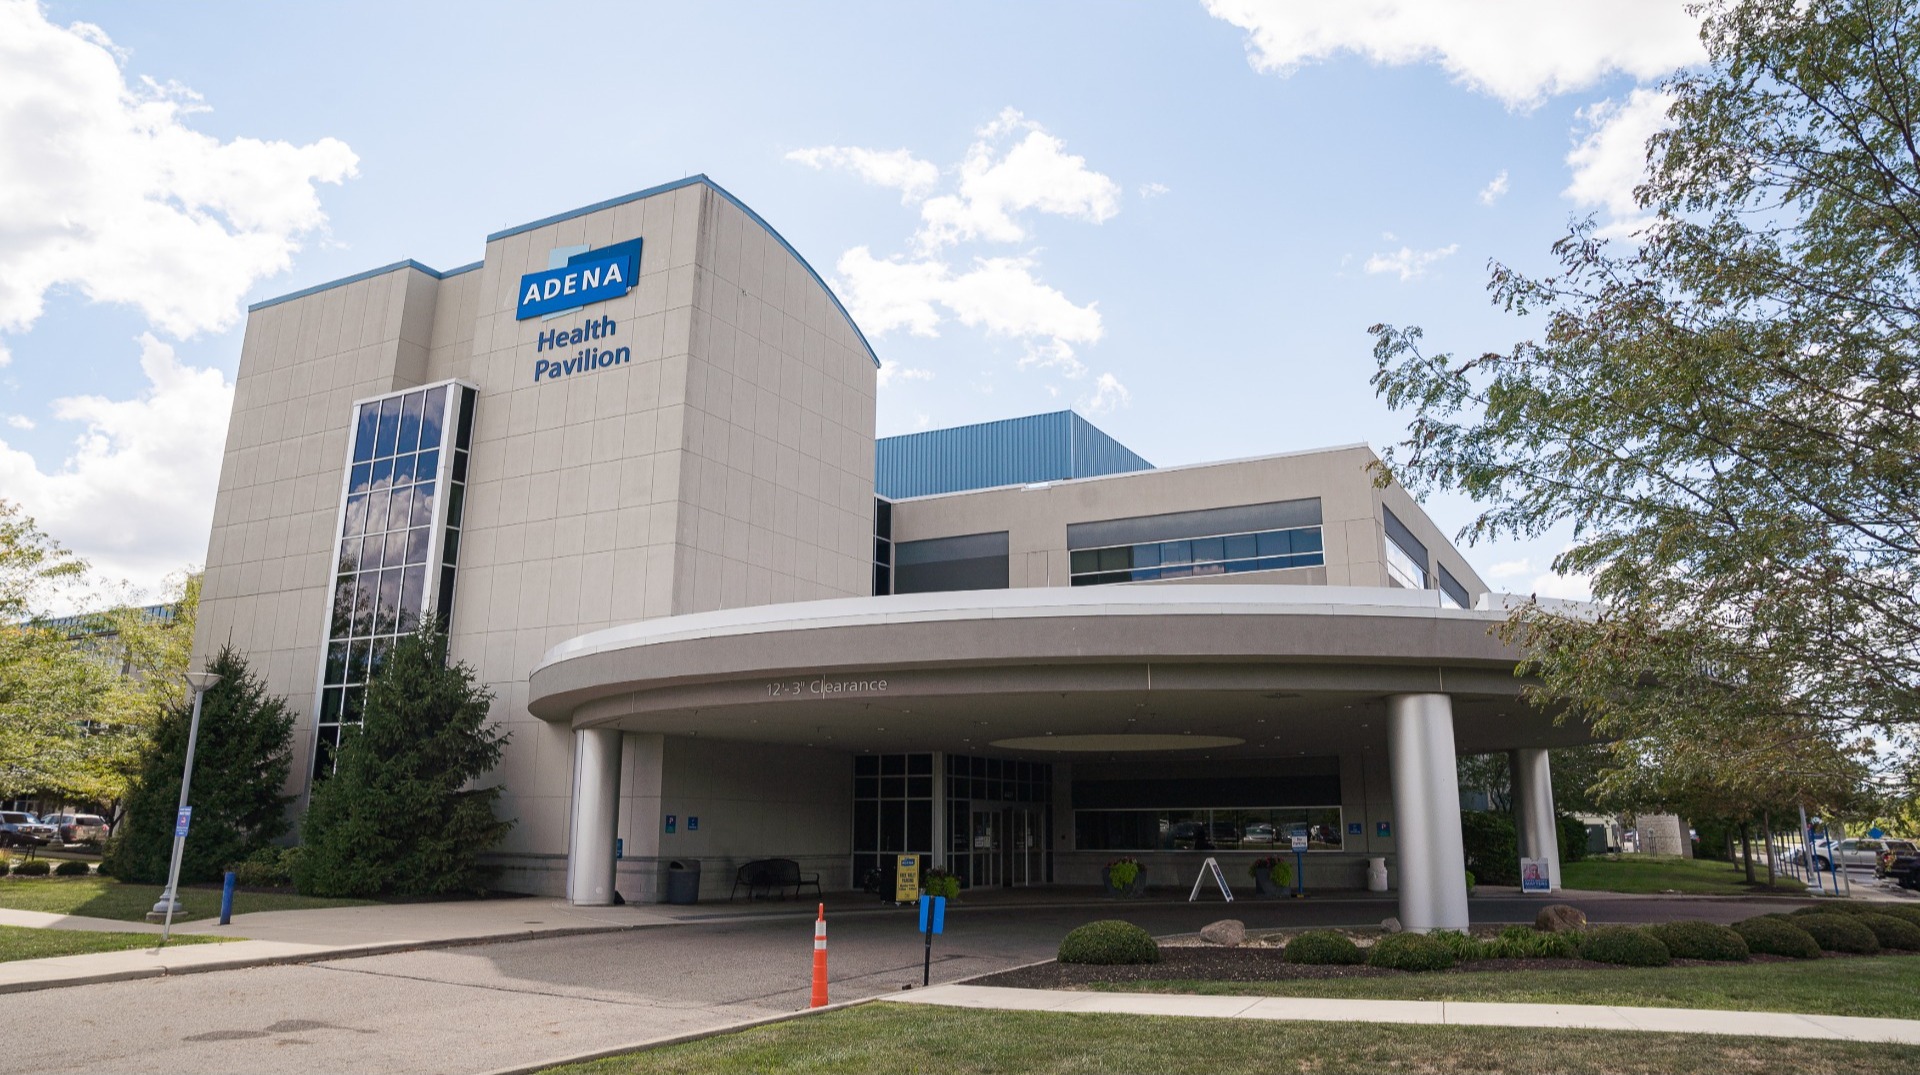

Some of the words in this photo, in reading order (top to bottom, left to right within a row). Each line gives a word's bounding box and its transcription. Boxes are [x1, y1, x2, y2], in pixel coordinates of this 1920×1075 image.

[523, 263, 623, 305] ADENA
[537, 315, 617, 353] Health
[534, 346, 631, 382] Pavilion
[810, 679, 888, 694] Clearance
